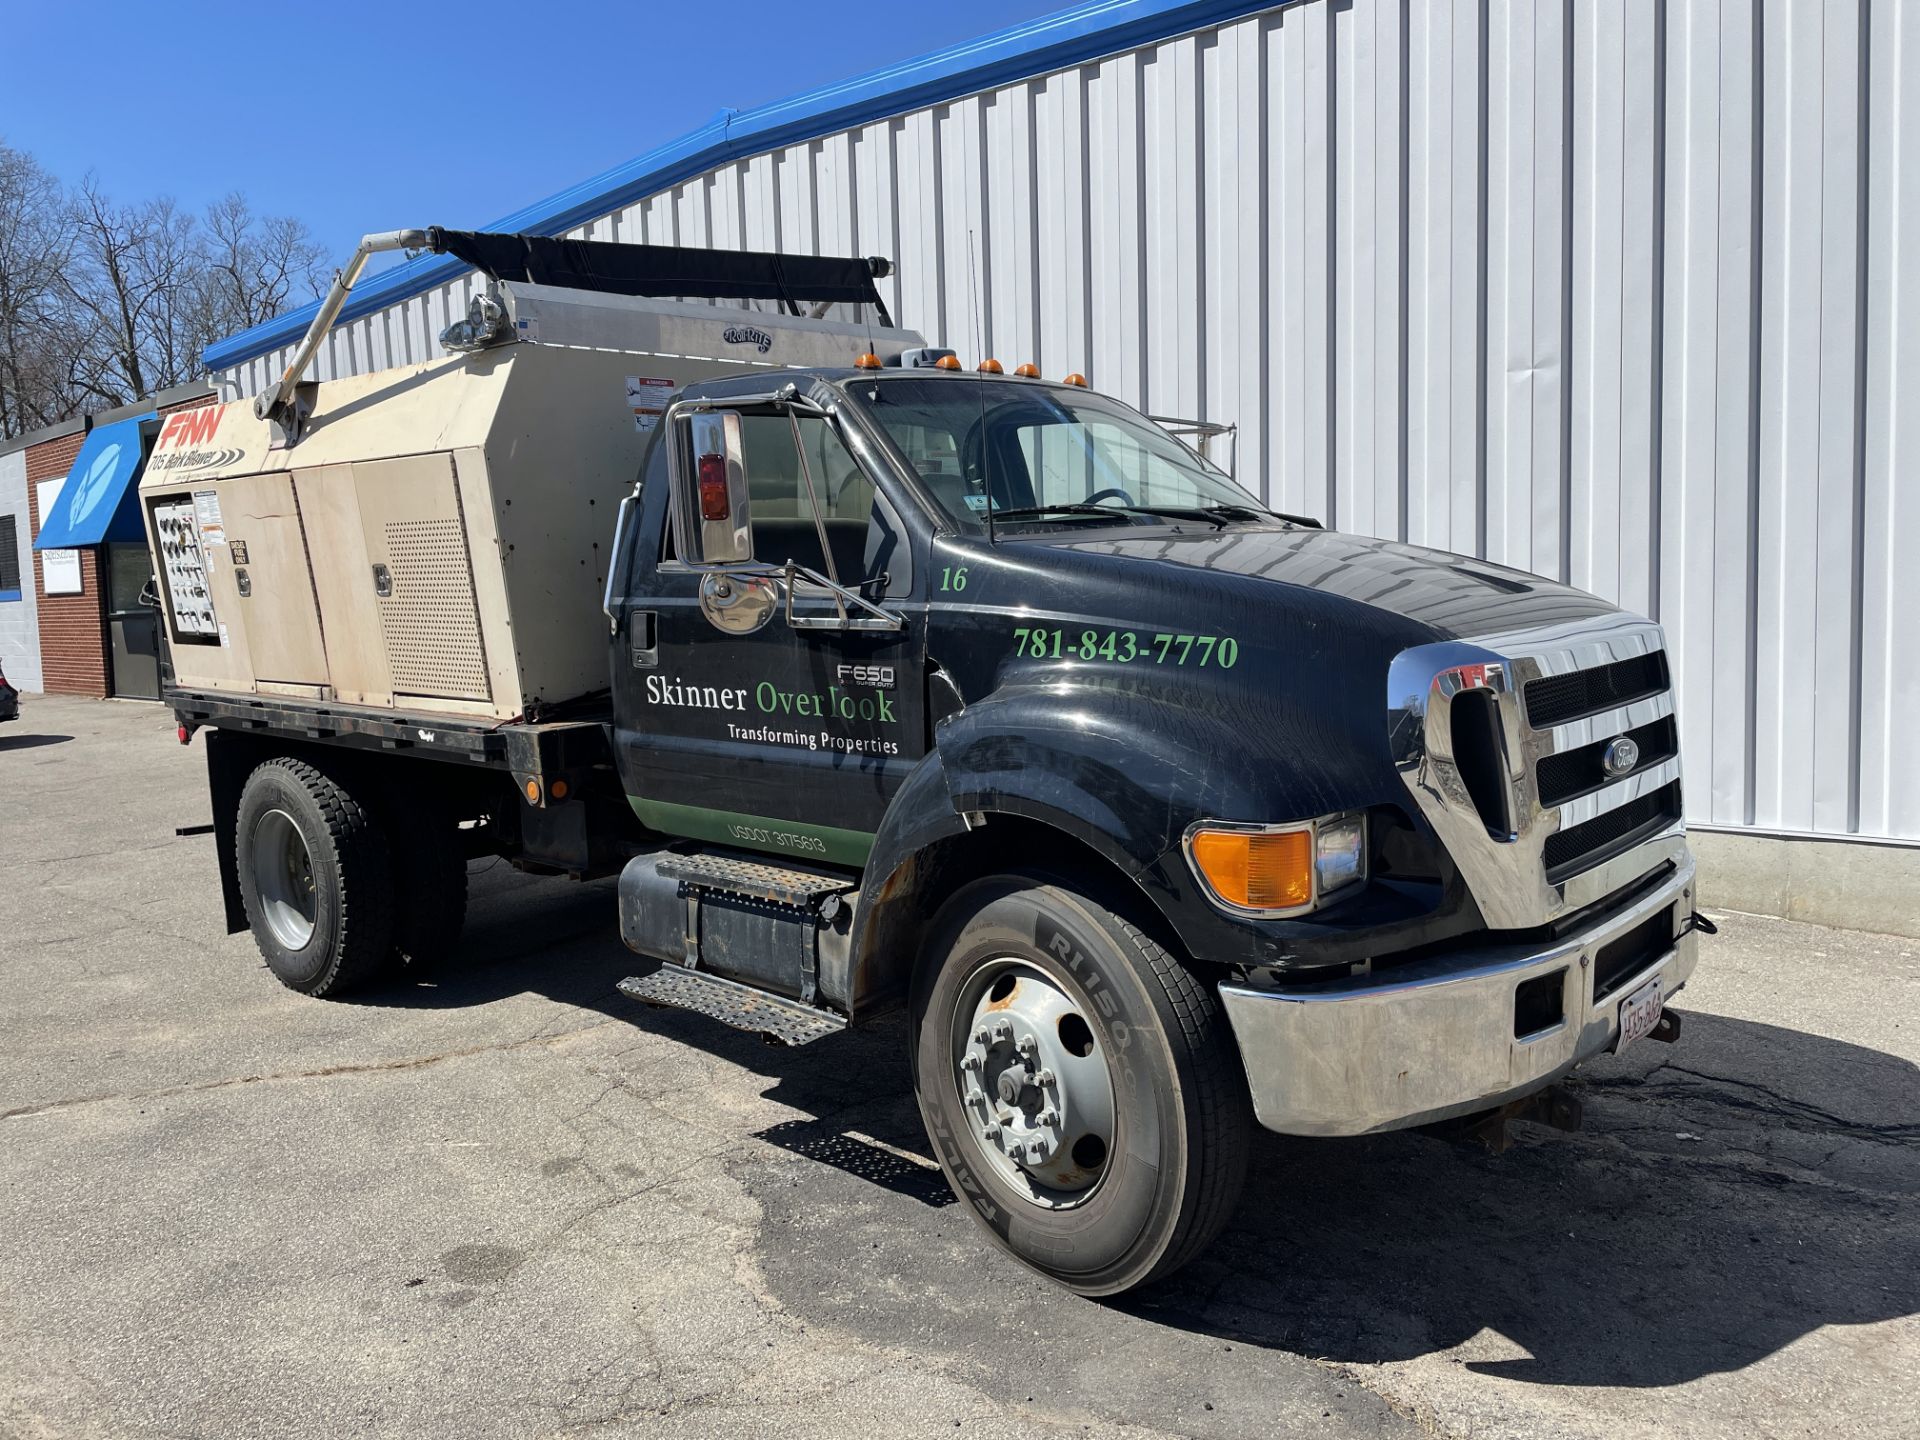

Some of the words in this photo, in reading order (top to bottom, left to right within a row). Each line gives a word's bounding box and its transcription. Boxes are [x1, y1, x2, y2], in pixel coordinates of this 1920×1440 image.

[147, 453, 168, 472] 705
[163, 451, 187, 470] Bark
[184, 448, 217, 467] Blower
[939, 567, 968, 592] 16
[1013, 627, 1239, 669] 781-843-7770
[646, 674, 748, 711] Skinner
[756, 681, 897, 723] Overlook
[726, 723, 818, 750] Transforming
[821, 731, 899, 755] Properties
[727, 823, 773, 844] USDOT
[775, 830, 827, 854] 3175613
